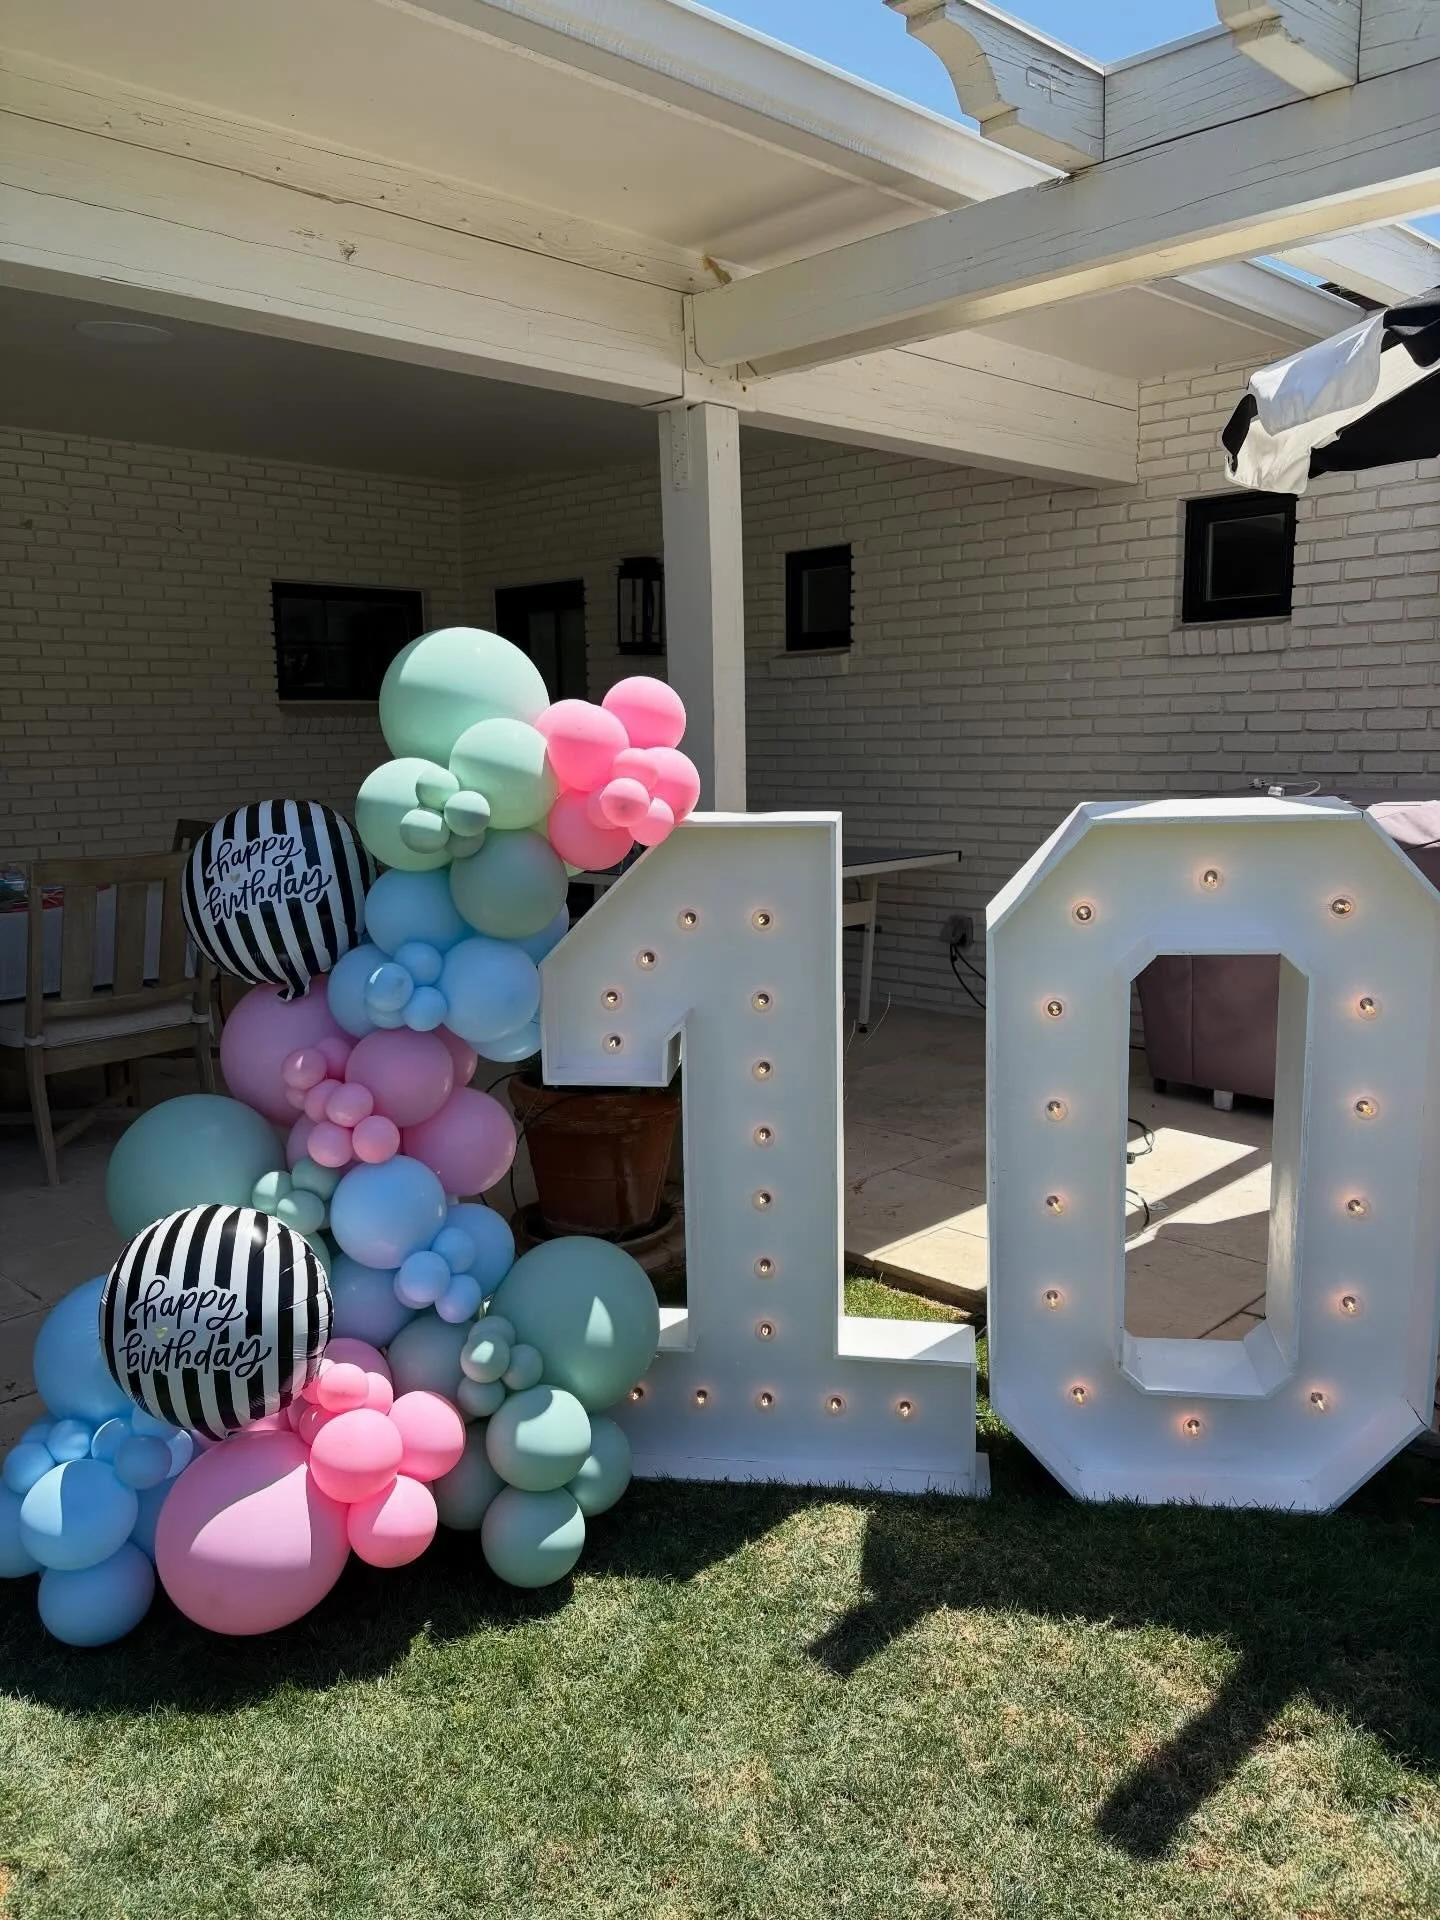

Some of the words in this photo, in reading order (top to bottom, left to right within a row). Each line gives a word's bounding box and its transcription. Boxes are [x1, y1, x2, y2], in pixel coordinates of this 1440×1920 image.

[206, 835, 302, 880] happy
[203, 868, 332, 922] birthday
[131, 1279, 244, 1331] happy
[119, 1329, 272, 1378] birthday
